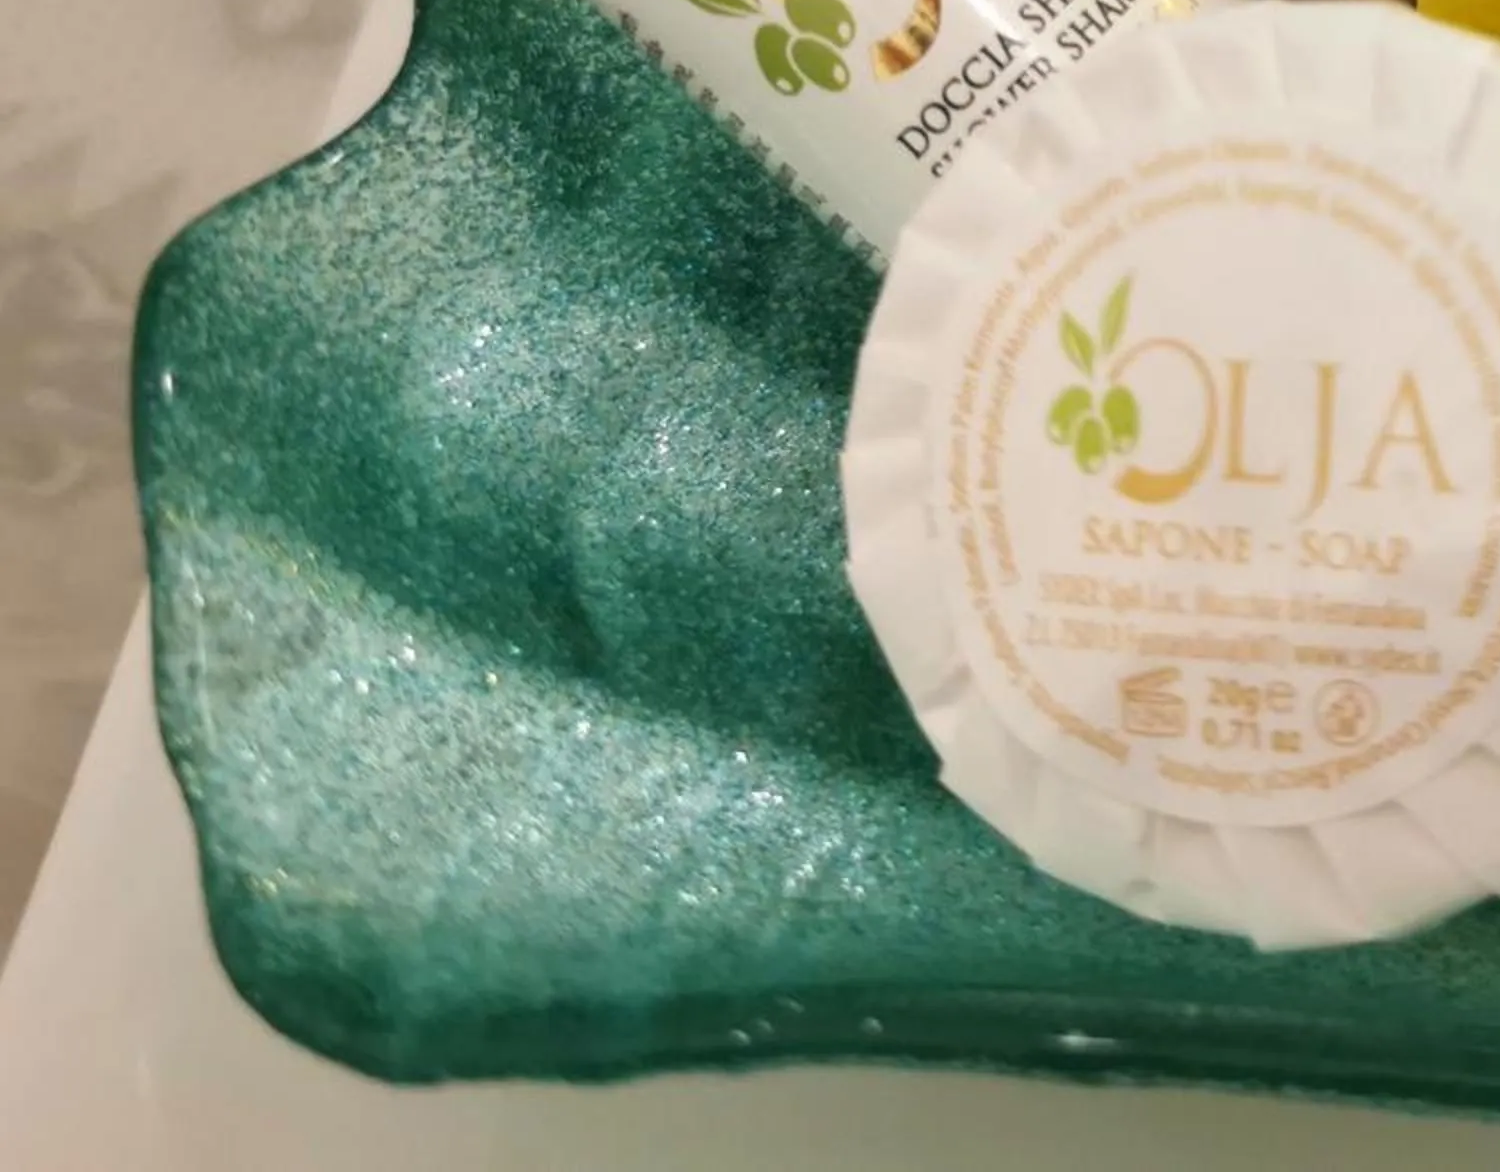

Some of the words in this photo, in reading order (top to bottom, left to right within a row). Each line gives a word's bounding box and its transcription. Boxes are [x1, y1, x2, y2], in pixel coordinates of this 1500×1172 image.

[897, 31, 1026, 160] DOCCIA
[1108, 338, 1459, 522] OLJA
[1082, 516, 1254, 564] SAPONE
[1300, 529, 1412, 574] SOAP
